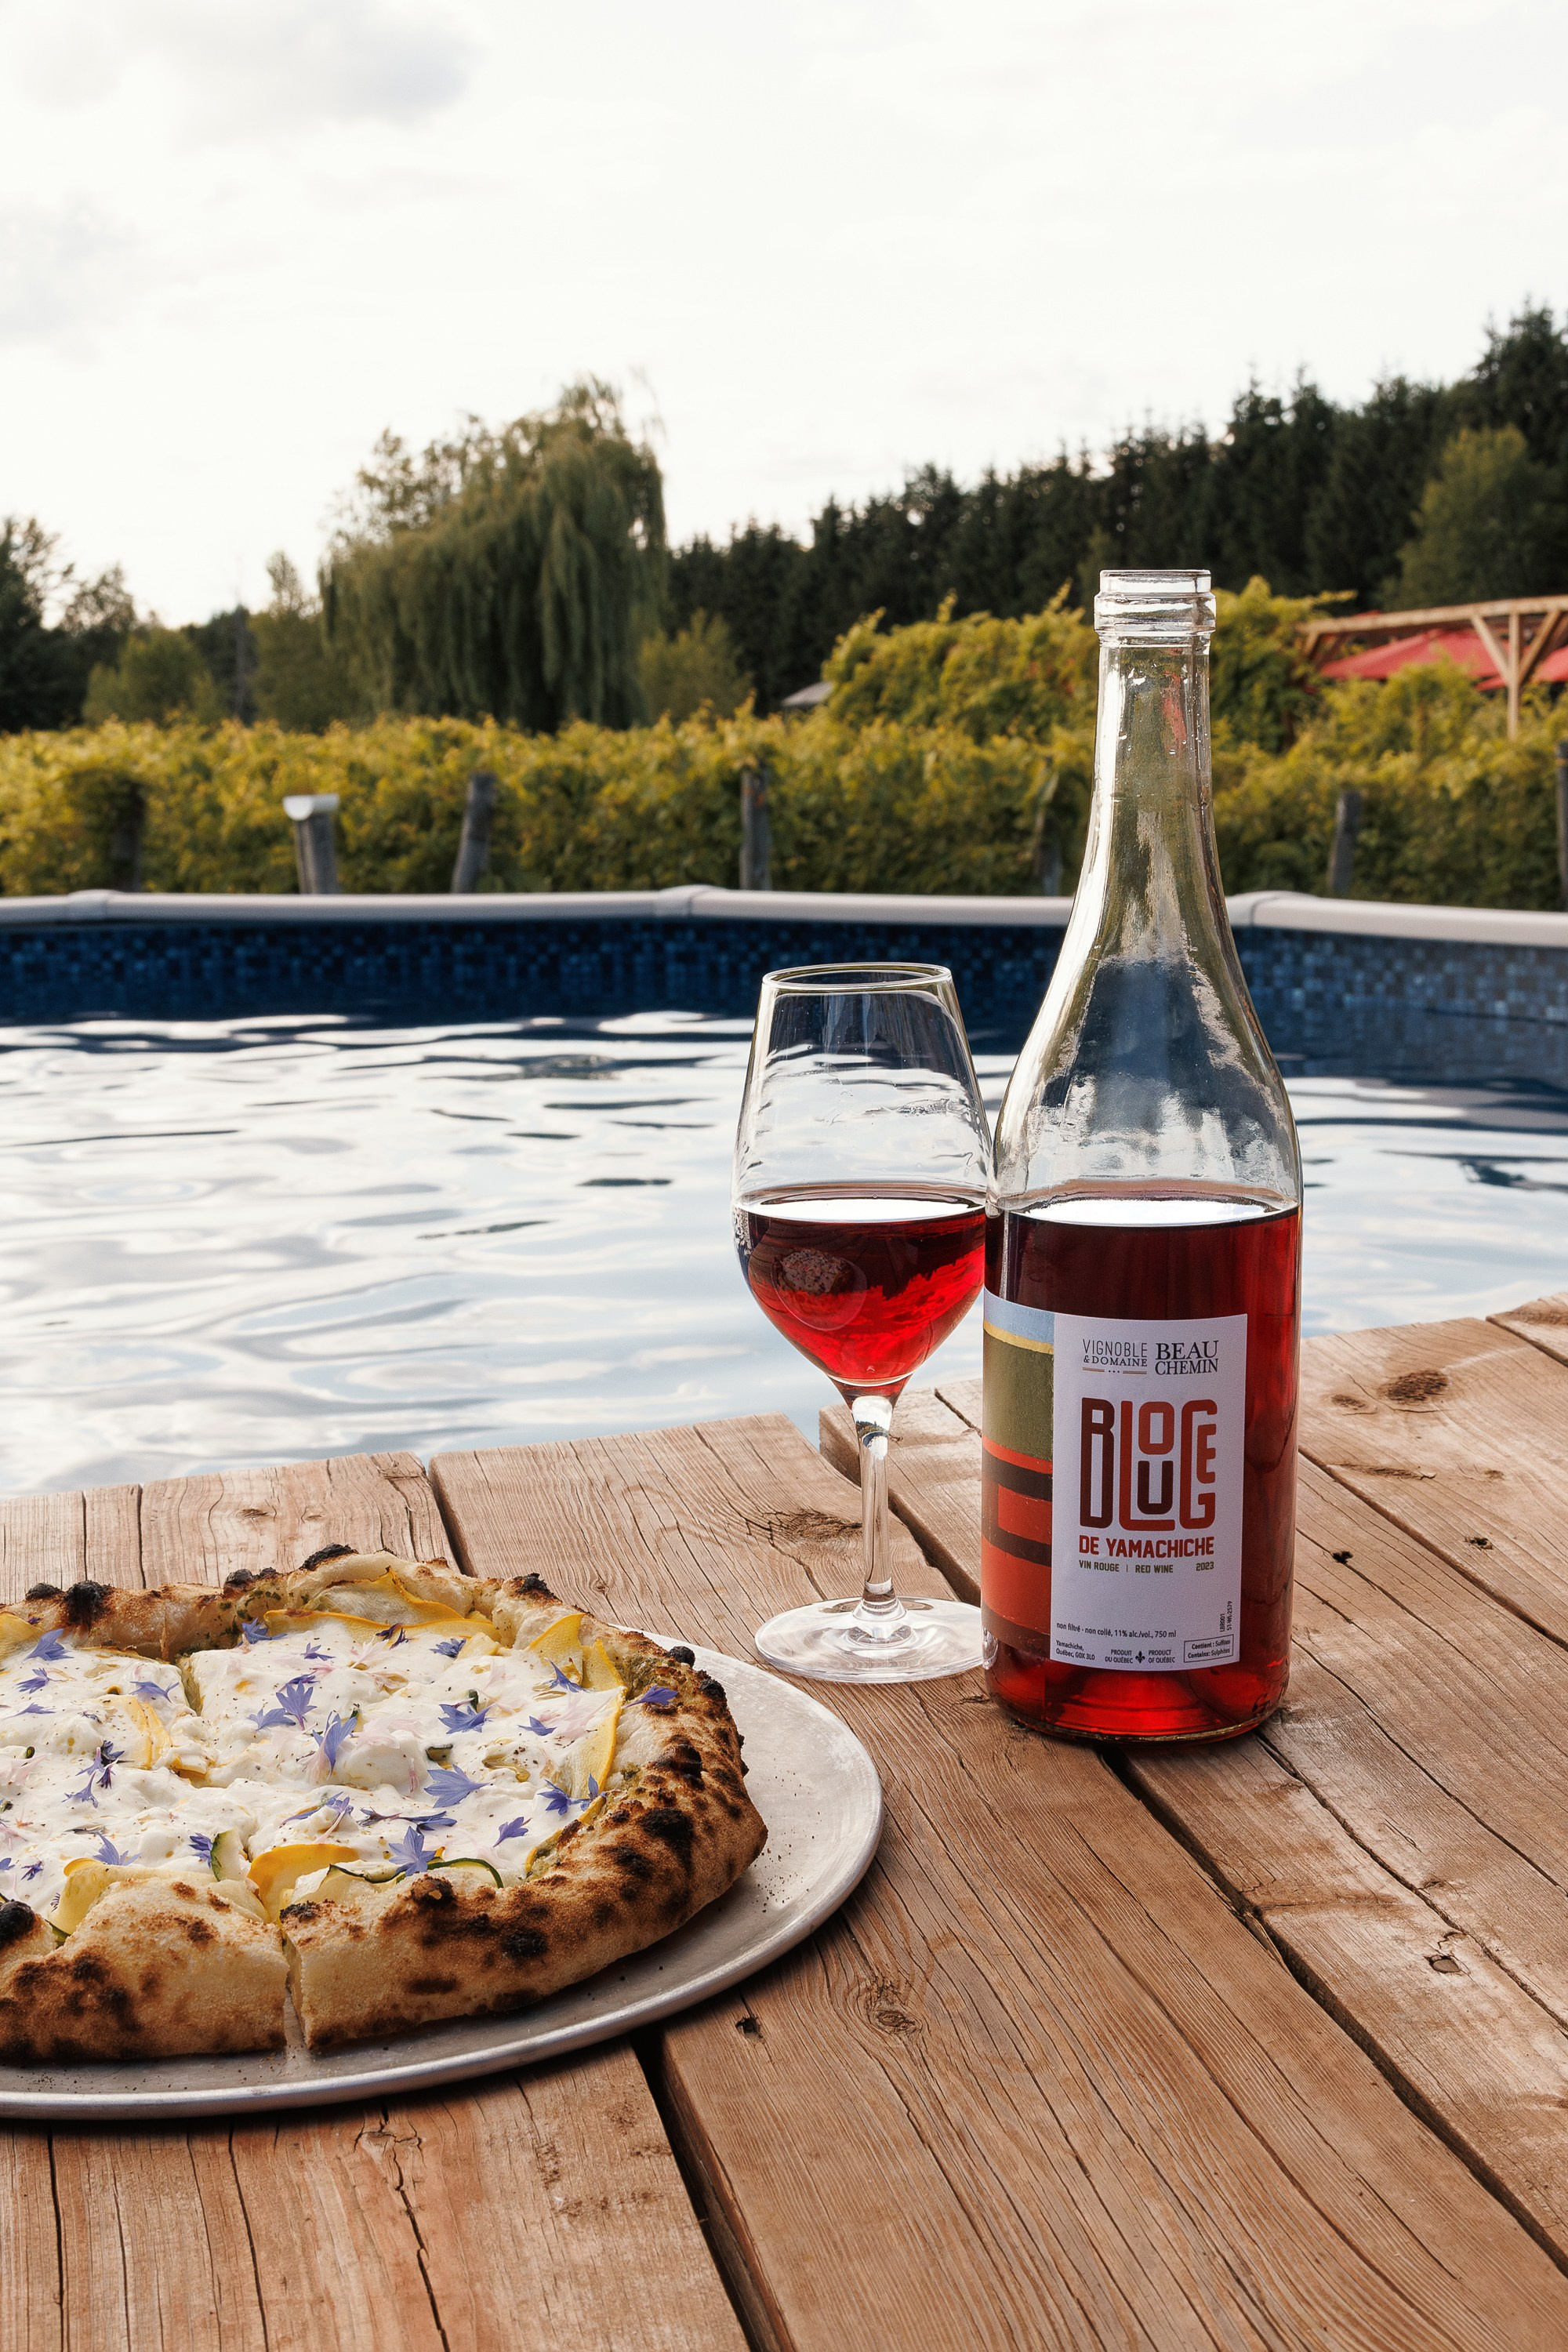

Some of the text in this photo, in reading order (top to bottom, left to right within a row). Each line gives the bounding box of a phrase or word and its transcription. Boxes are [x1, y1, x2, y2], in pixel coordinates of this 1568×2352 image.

[1083, 1339, 1148, 1357] VIGNOBLE
[1156, 1341, 1219, 1359] BEAU
[1155, 1359, 1219, 1375] CHEMIN
[1079, 1535, 1214, 1559] DE YAMACHICHE
[1079, 1560, 1120, 1573] VIN ROUGE
[1135, 1565, 1174, 1573] RED WINE
[1196, 1562, 1214, 1572] 2023
[1068, 1624, 1080, 1632] filtré
